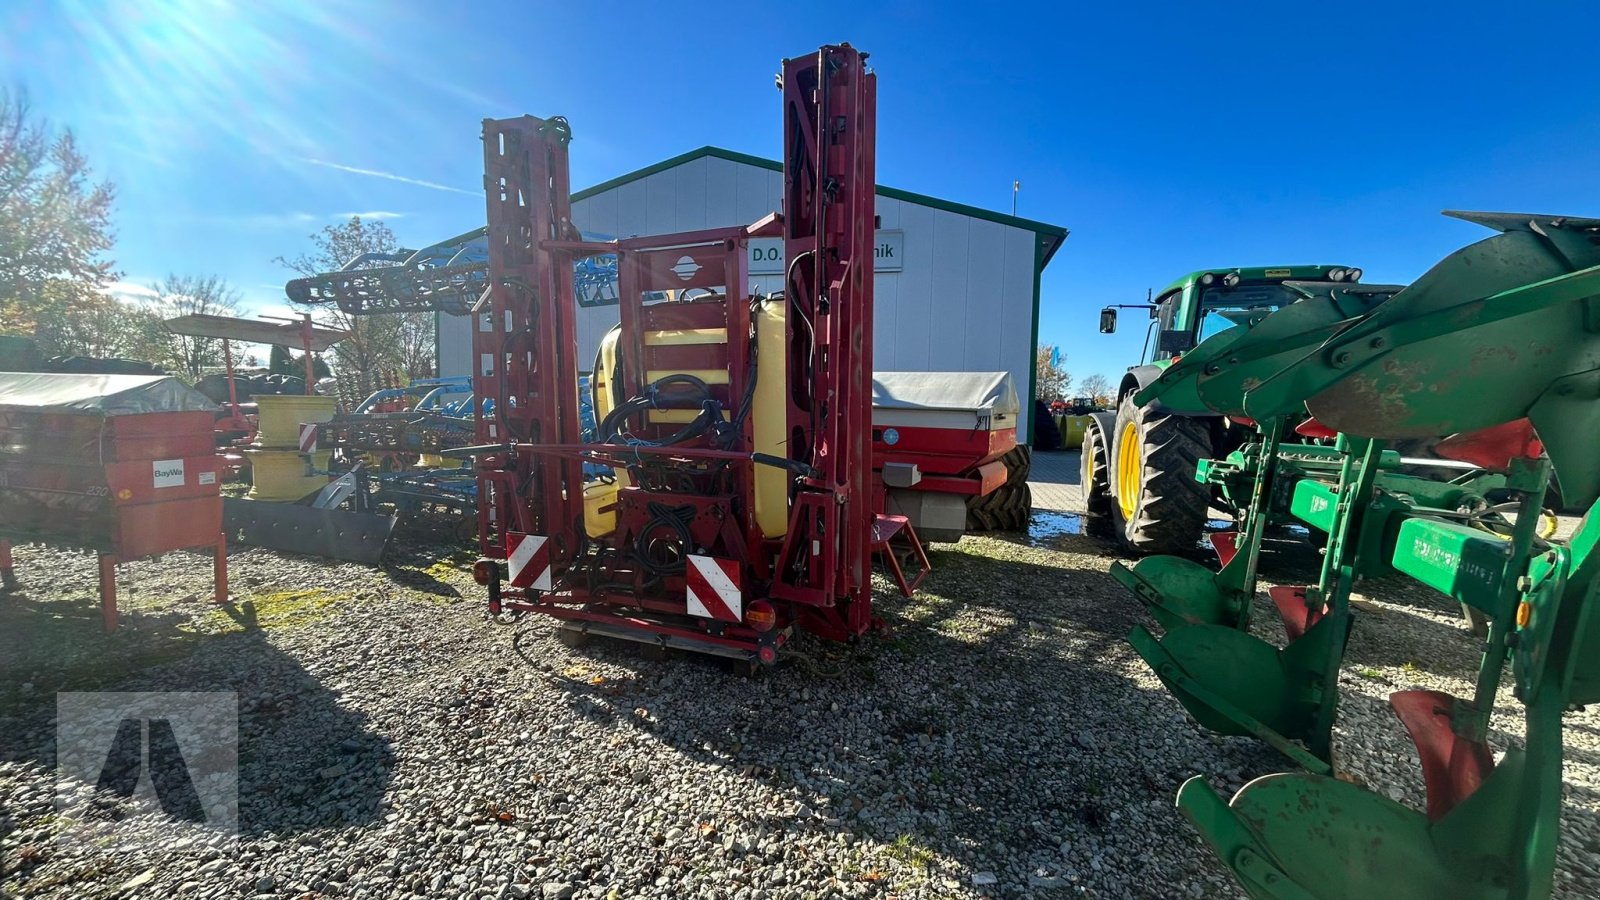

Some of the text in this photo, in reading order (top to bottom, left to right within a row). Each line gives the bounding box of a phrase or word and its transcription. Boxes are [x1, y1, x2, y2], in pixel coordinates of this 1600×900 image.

[753, 248, 782, 261] D.O.
[154, 468, 183, 478] BayWa
[86, 486, 109, 497] 230
